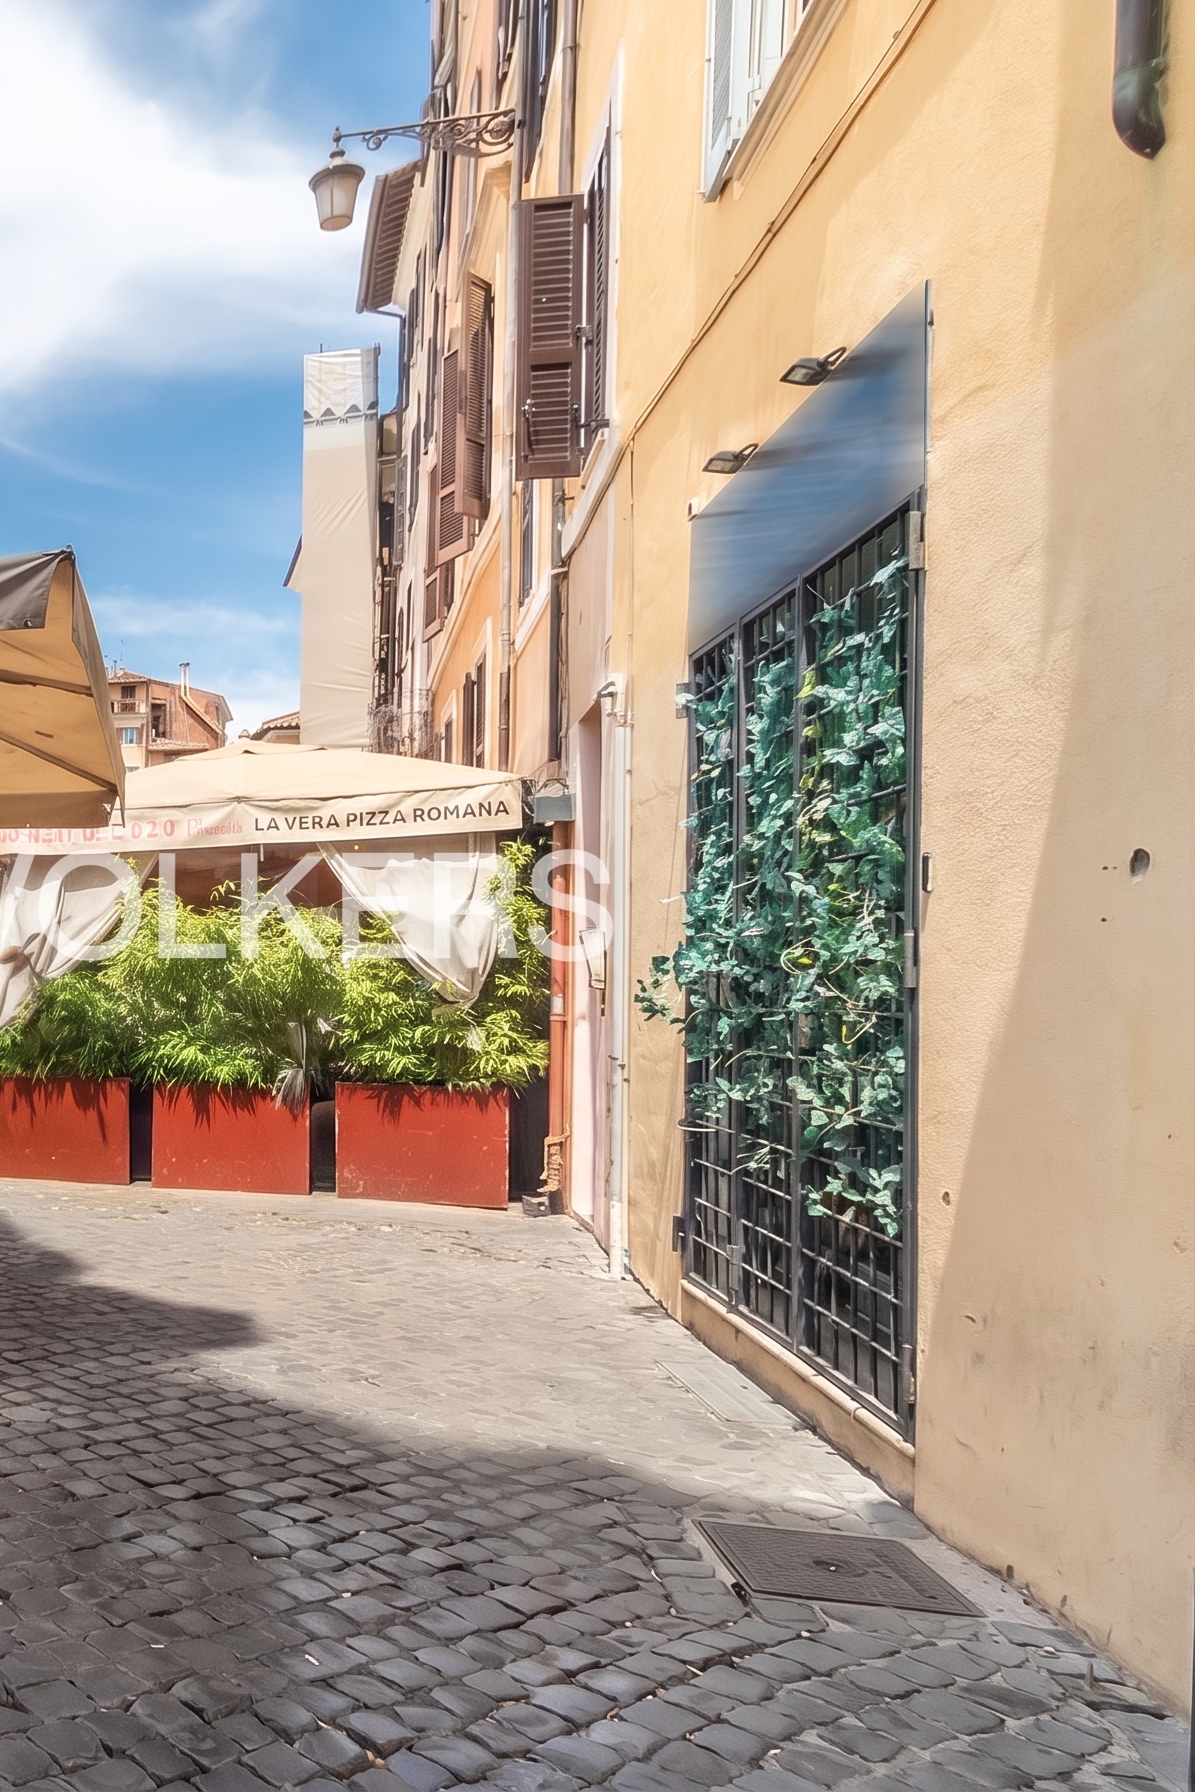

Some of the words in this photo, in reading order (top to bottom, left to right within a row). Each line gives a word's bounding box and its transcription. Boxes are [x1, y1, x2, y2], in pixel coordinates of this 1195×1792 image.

[254, 817, 280, 832] LA
[284, 814, 340, 830] VERA
[345, 809, 405, 828] PIZZA
[412, 800, 510, 823] ROMANA
